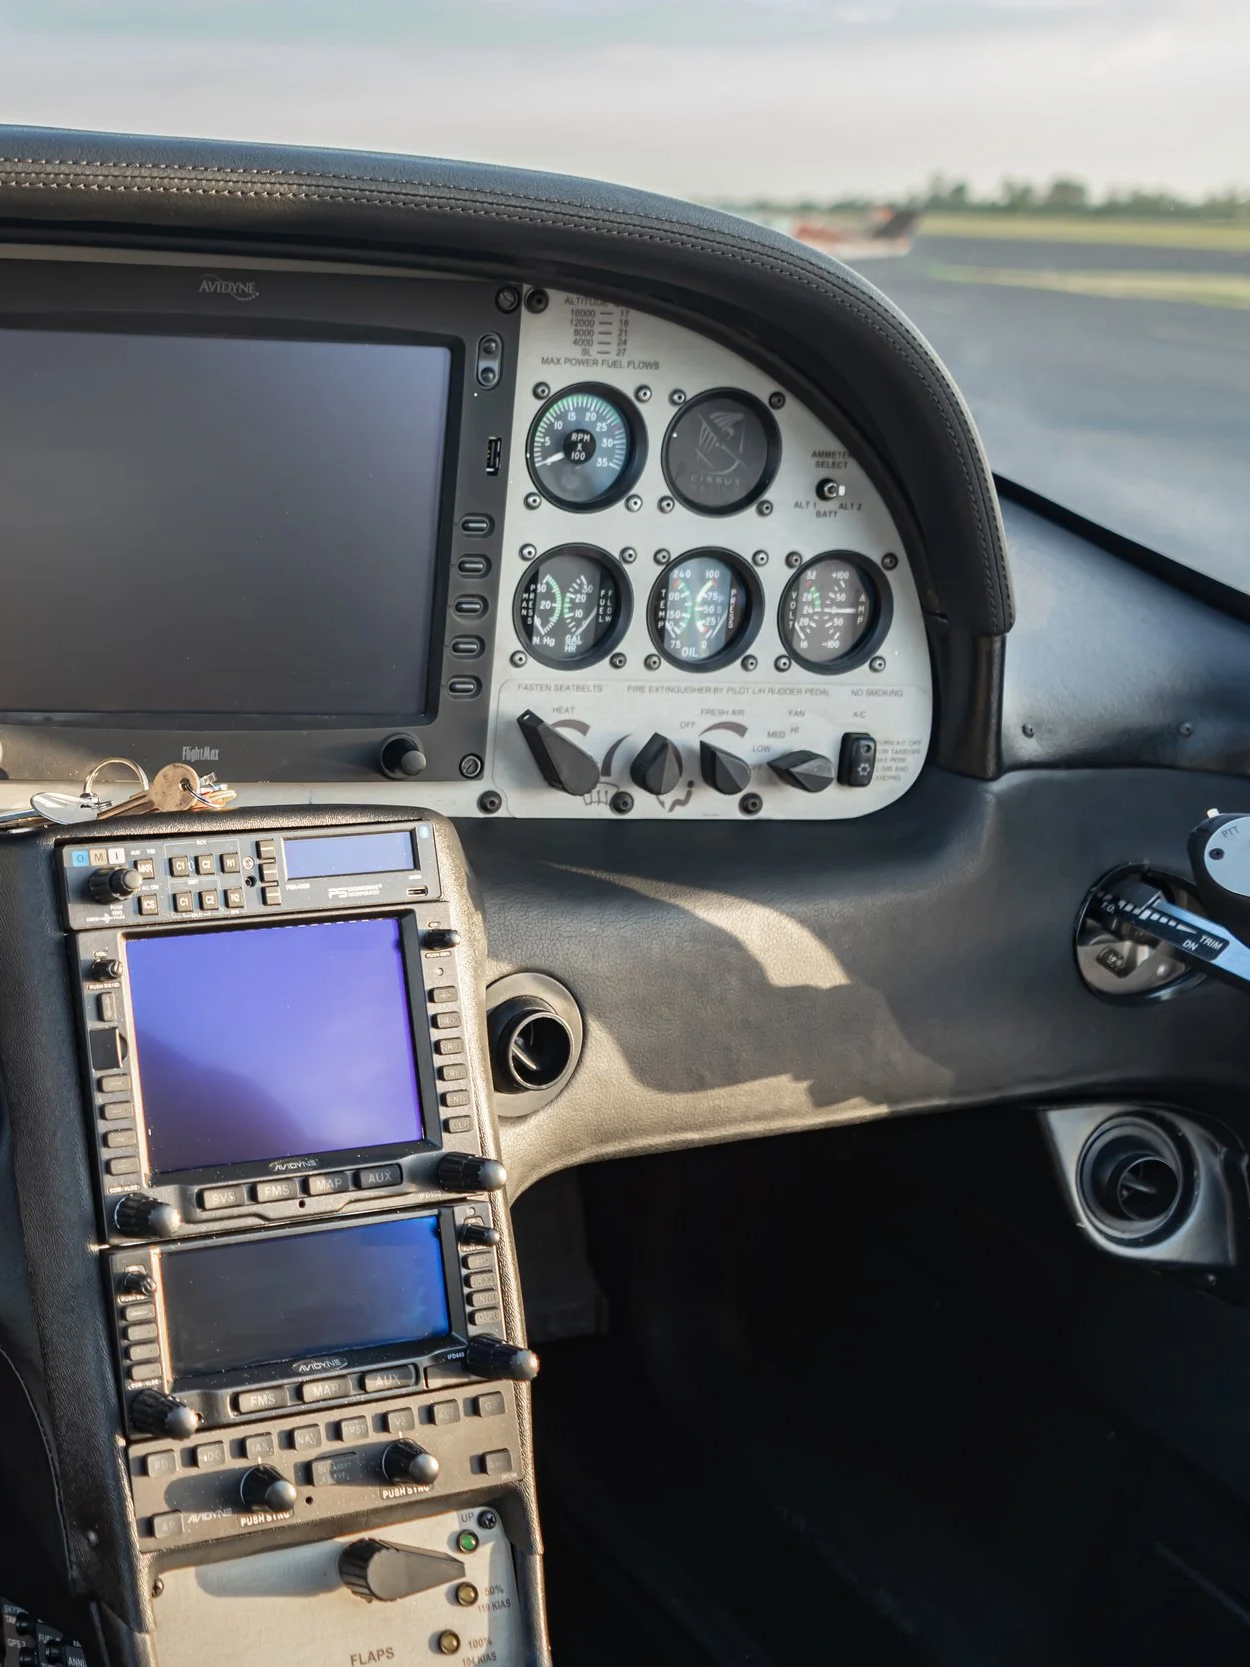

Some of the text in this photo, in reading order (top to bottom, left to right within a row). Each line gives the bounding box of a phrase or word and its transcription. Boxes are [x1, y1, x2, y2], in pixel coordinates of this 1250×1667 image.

[199, 279, 257, 294] AVIDYNE
[541, 357, 660, 370] MAX POWER FUEL FLOWS
[568, 412, 597, 421] 15 20
[554, 421, 607, 432] 10 25
[572, 433, 591, 442] RPM
[571, 452, 586, 460] 100
[596, 457, 608, 468] 35
[815, 460, 848, 469] SELECT
[691, 475, 741, 486] CIRRUS
[816, 510, 838, 519] BATT
[681, 647, 699, 657] OIL
[517, 683, 603, 693] FASTEN SEATBELTS
[627, 685, 648, 693] FIRE
[648, 685, 712, 695] EXTINGUISHER
[713, 686, 724, 695] BY
[726, 686, 750, 695] PILOT
[767, 687, 803, 696] RUDDER
[805, 688, 831, 696] PEDAL
[851, 689, 903, 697] NO SMOKING
[182, 746, 219, 763] FlightMax
[1221, 826, 1240, 839] PTT
[176, 861, 185, 870] C1
[202, 860, 211, 869] C2
[227, 859, 235, 867] N1
[180, 898, 189, 906] C1
[206, 896, 215, 904] C2
[231, 893, 240, 903] N2
[144, 900, 155, 909] ICS
[1182, 935, 1224, 951] DN TRIM
[274, 1159, 318, 1172] AVIDYNE
[368, 1171, 393, 1183] AUX
[316, 1178, 343, 1190] MAP
[264, 1186, 289, 1197] FMS
[212, 1192, 237, 1205] SVS
[298, 1359, 343, 1372] AVIDYNE
[374, 1374, 401, 1386] AUX
[314, 1384, 341, 1397] MAP
[250, 1395, 276, 1406] FMS
[187, 1508, 233, 1524] AVIDYNE
[461, 1513, 475, 1523] UP
[350, 1647, 395, 1667] FLAPS
